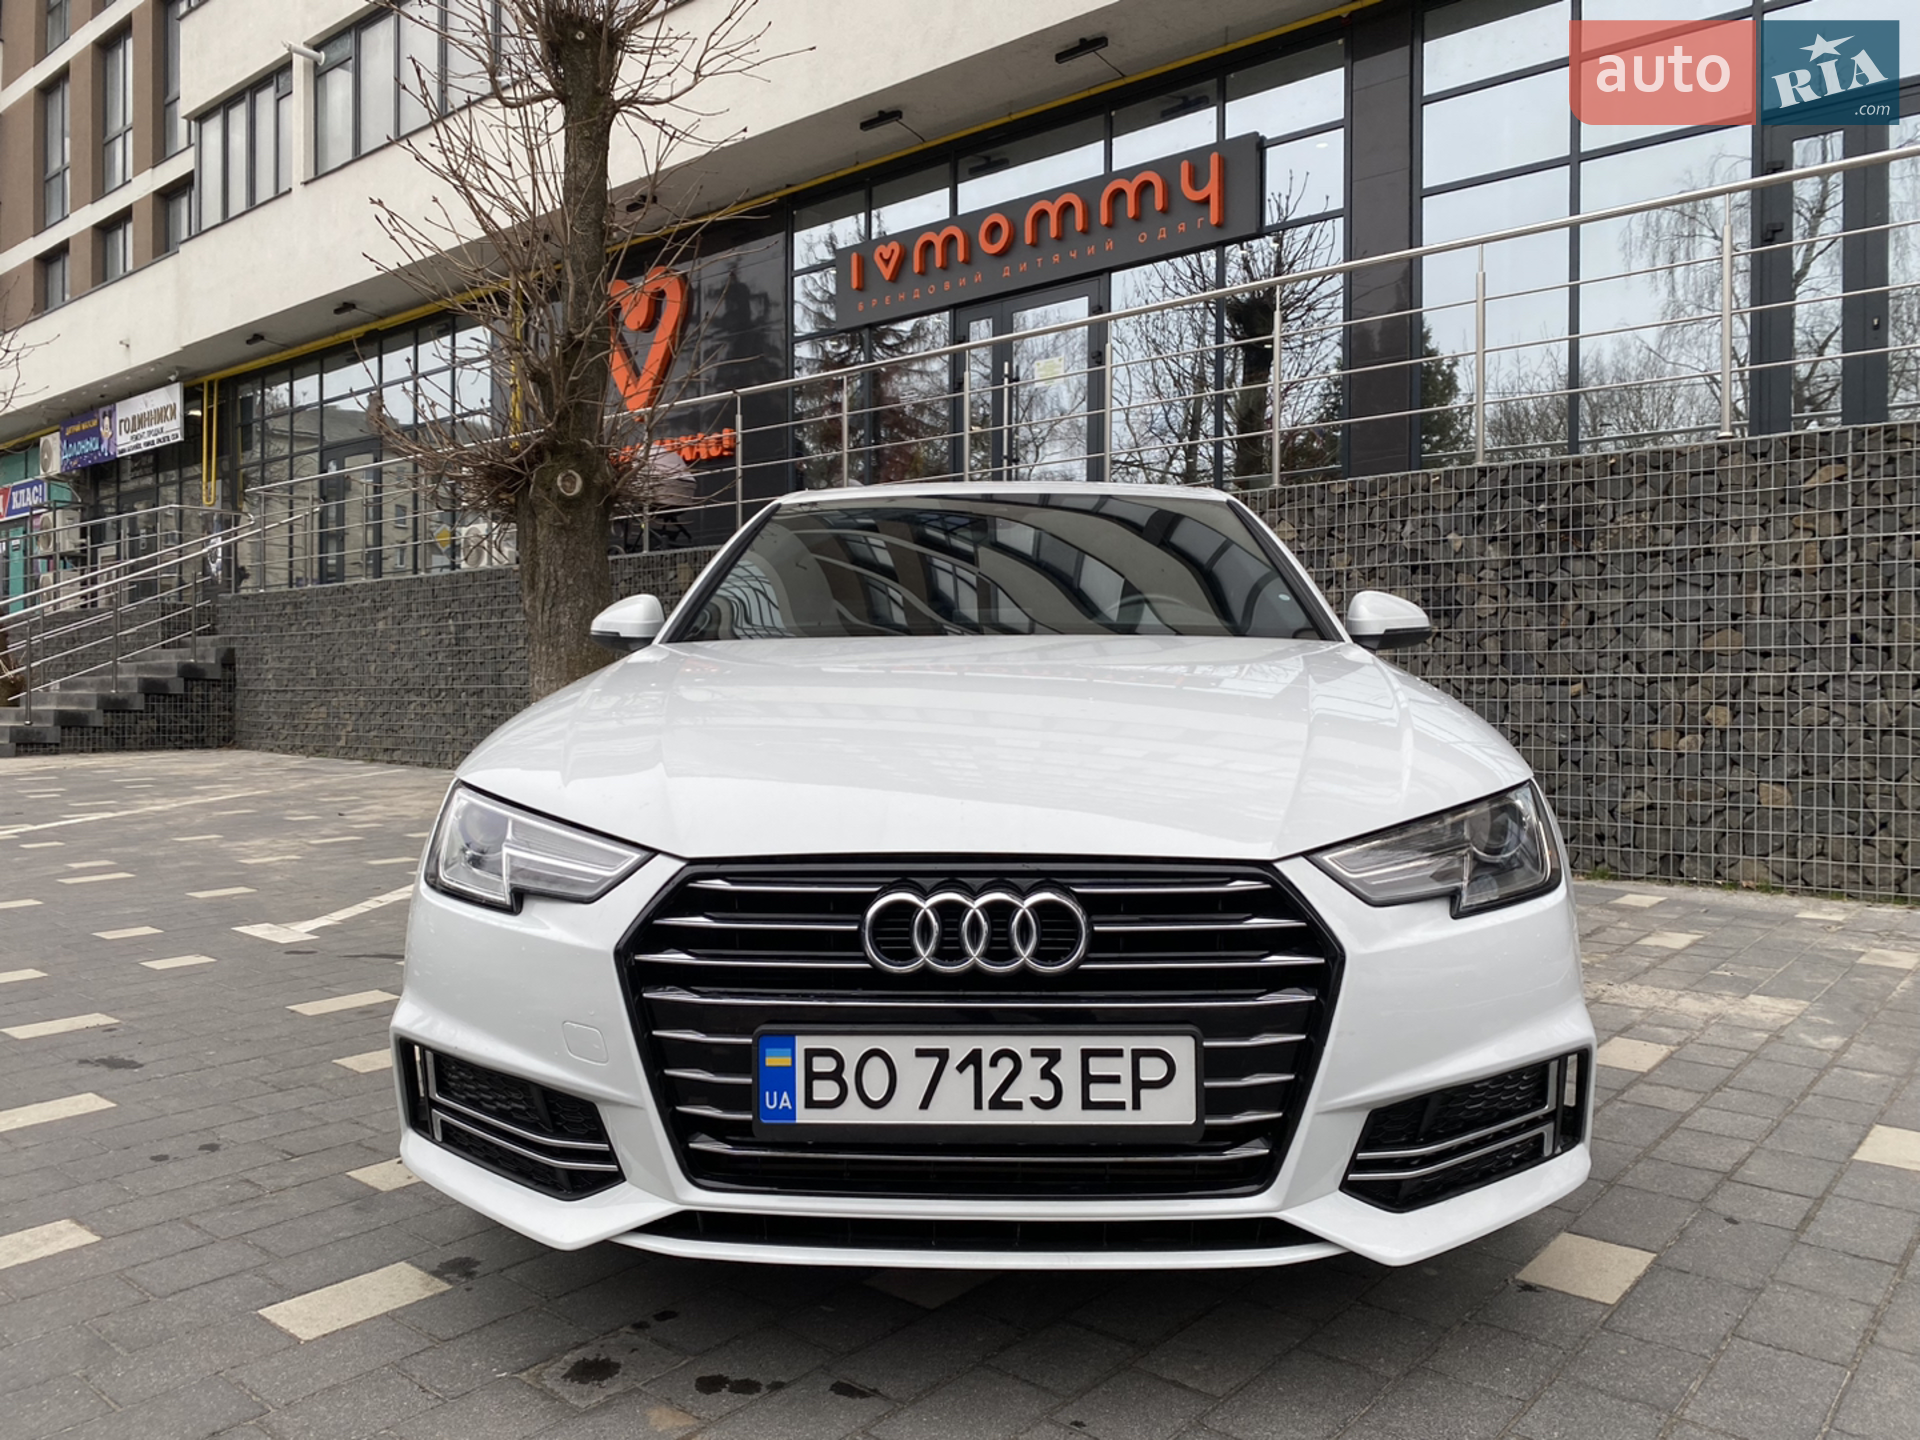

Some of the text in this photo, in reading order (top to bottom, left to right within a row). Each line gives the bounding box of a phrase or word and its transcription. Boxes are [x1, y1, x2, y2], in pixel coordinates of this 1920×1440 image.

[913, 151, 1224, 275] mommy
[858, 217, 1205, 312] БРЕНДОВИЙ ДИТЯЧИЙ ОДЯГ
[118, 402, 177, 437] ГОДИННИКИ
[11, 484, 43, 510] КЛАС!
[765, 1090, 792, 1110] UA
[803, 1046, 1177, 1111] BO 7123 EP
